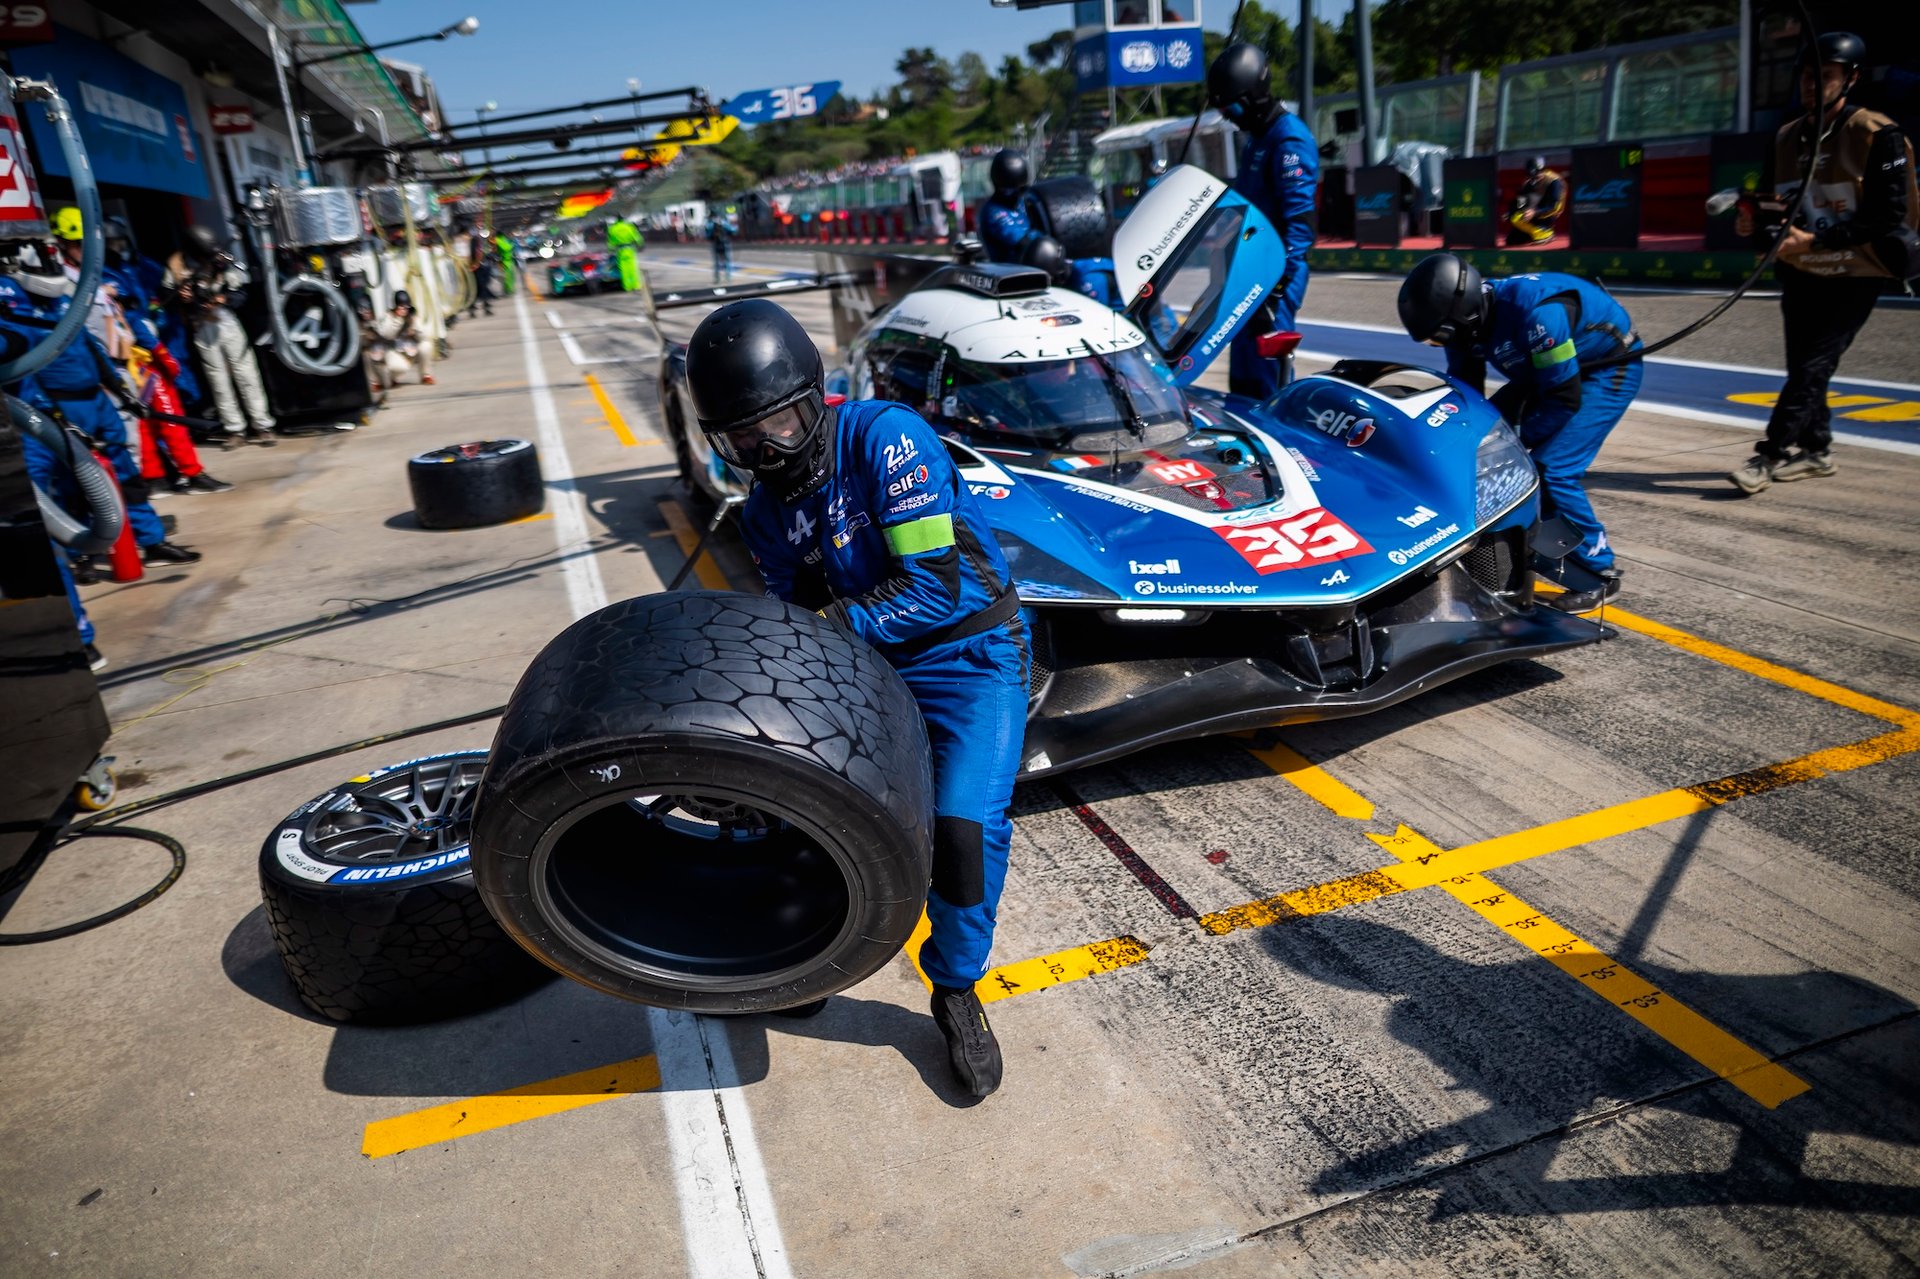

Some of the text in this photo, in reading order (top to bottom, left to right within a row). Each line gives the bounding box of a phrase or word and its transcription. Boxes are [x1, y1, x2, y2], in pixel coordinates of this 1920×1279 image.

[0, 5, 47, 27] 9
[768, 85, 817, 119] 36
[1574, 180, 1633, 201] WEC
[1150, 184, 1214, 257] businessolver
[958, 274, 993, 290] ALTEN
[1206, 283, 1264, 349] MOSER.WATCH
[1001, 330, 1144, 360] ALPINE
[1316, 409, 1356, 437] elf
[1427, 406, 1450, 428] elf
[883, 433, 915, 469] 24h
[888, 450, 919, 475] LE MANS
[1153, 462, 1202, 482] HY
[888, 472, 915, 497] elf
[968, 484, 988, 496] lf
[889, 493, 949, 514] TECHNOLOGY
[1071, 485, 1154, 515] MOSER.WATCH
[1224, 502, 1286, 522] WEC
[1397, 505, 1439, 528] ixell
[1226, 511, 1360, 569] 36
[1399, 523, 1460, 558] businessolver
[803, 547, 823, 565] elf
[1129, 559, 1181, 575] ixell
[1157, 581, 1259, 594] businessolver
[877, 603, 920, 625] PINE
[282, 832, 297, 840] S
[286, 853, 330, 876] PILOT SPORT
[342, 847, 469, 881] MICHELIN
[1516, 918, 1540, 930] 30
[1551, 942, 1574, 954] 40
[1591, 967, 1617, 980] 50
[1632, 994, 1661, 1009] 60
